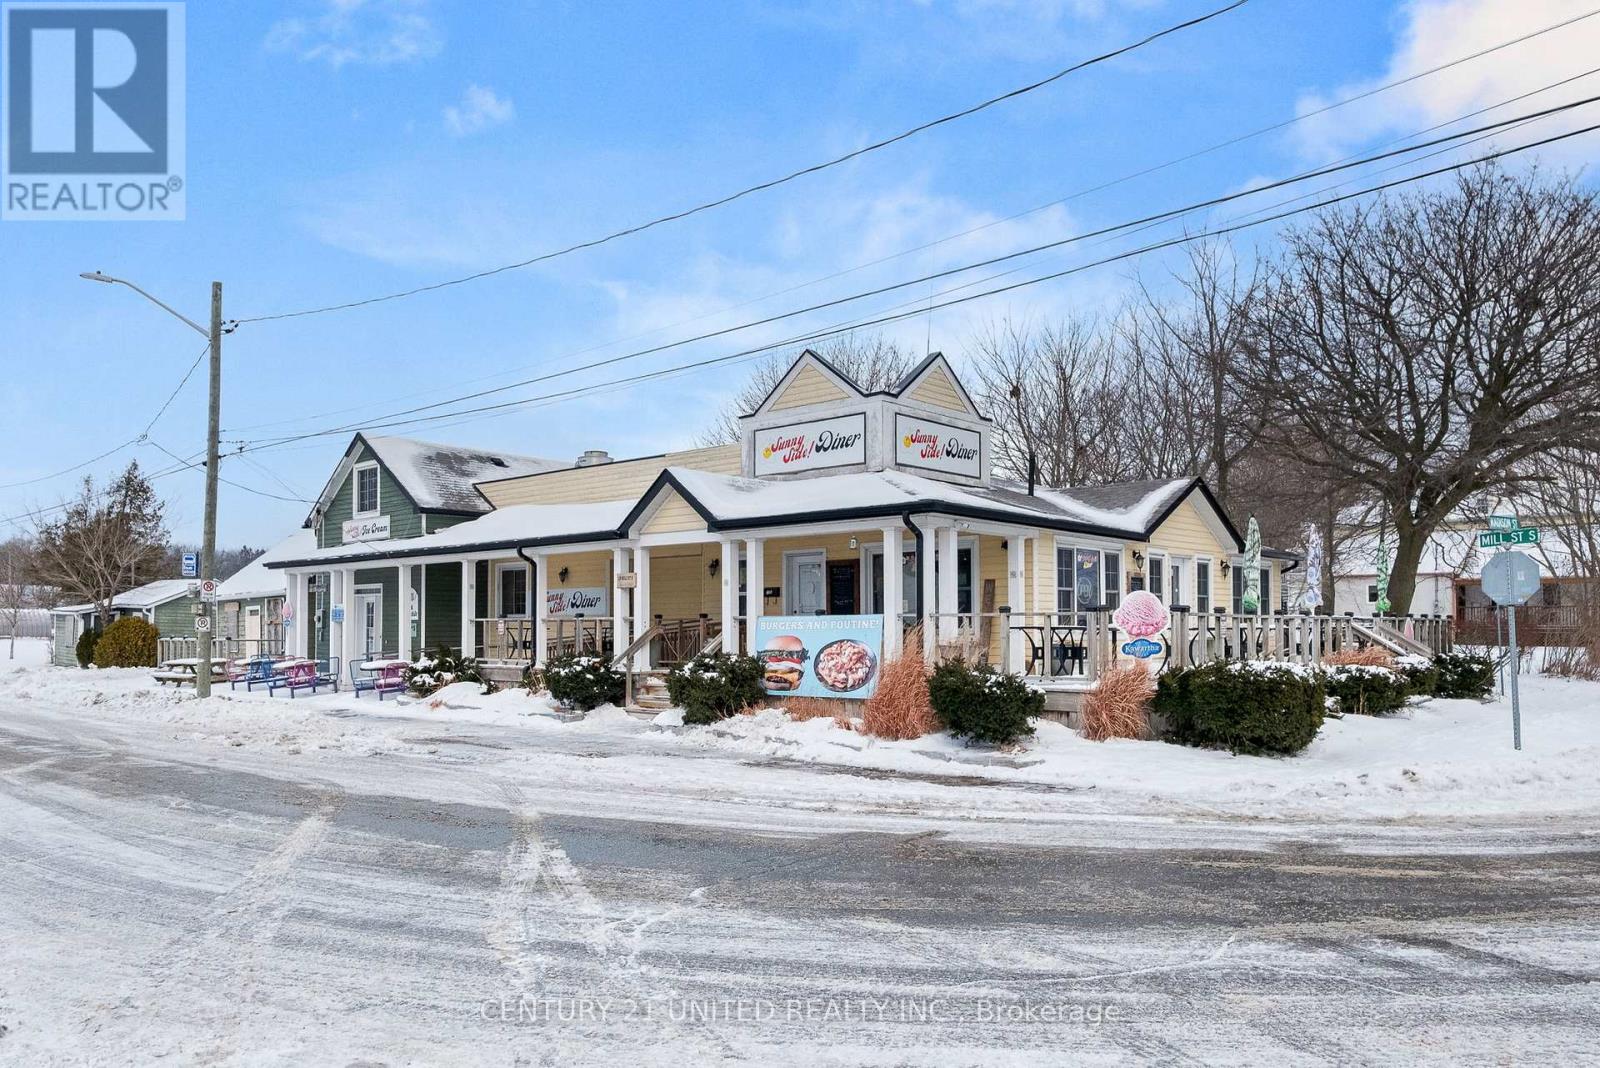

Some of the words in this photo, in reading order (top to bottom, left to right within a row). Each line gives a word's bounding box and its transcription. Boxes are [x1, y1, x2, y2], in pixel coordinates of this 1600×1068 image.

[771, 435, 805, 453] Sunny
[815, 430, 862, 453] Diner
[910, 428, 939, 449] Sunny
[946, 437, 978, 461] Diner
[371, 522, 388, 534] Cream
[1481, 533, 1503, 546] MILL
[1510, 531, 1524, 543] ST
[1528, 530, 1537, 541] S
[546, 591, 565, 605] unny
[570, 590, 601, 609] Diner
[760, 621, 804, 630] BURGERS
[806, 621, 828, 630] AND
[830, 619, 880, 629] POUTINE!
